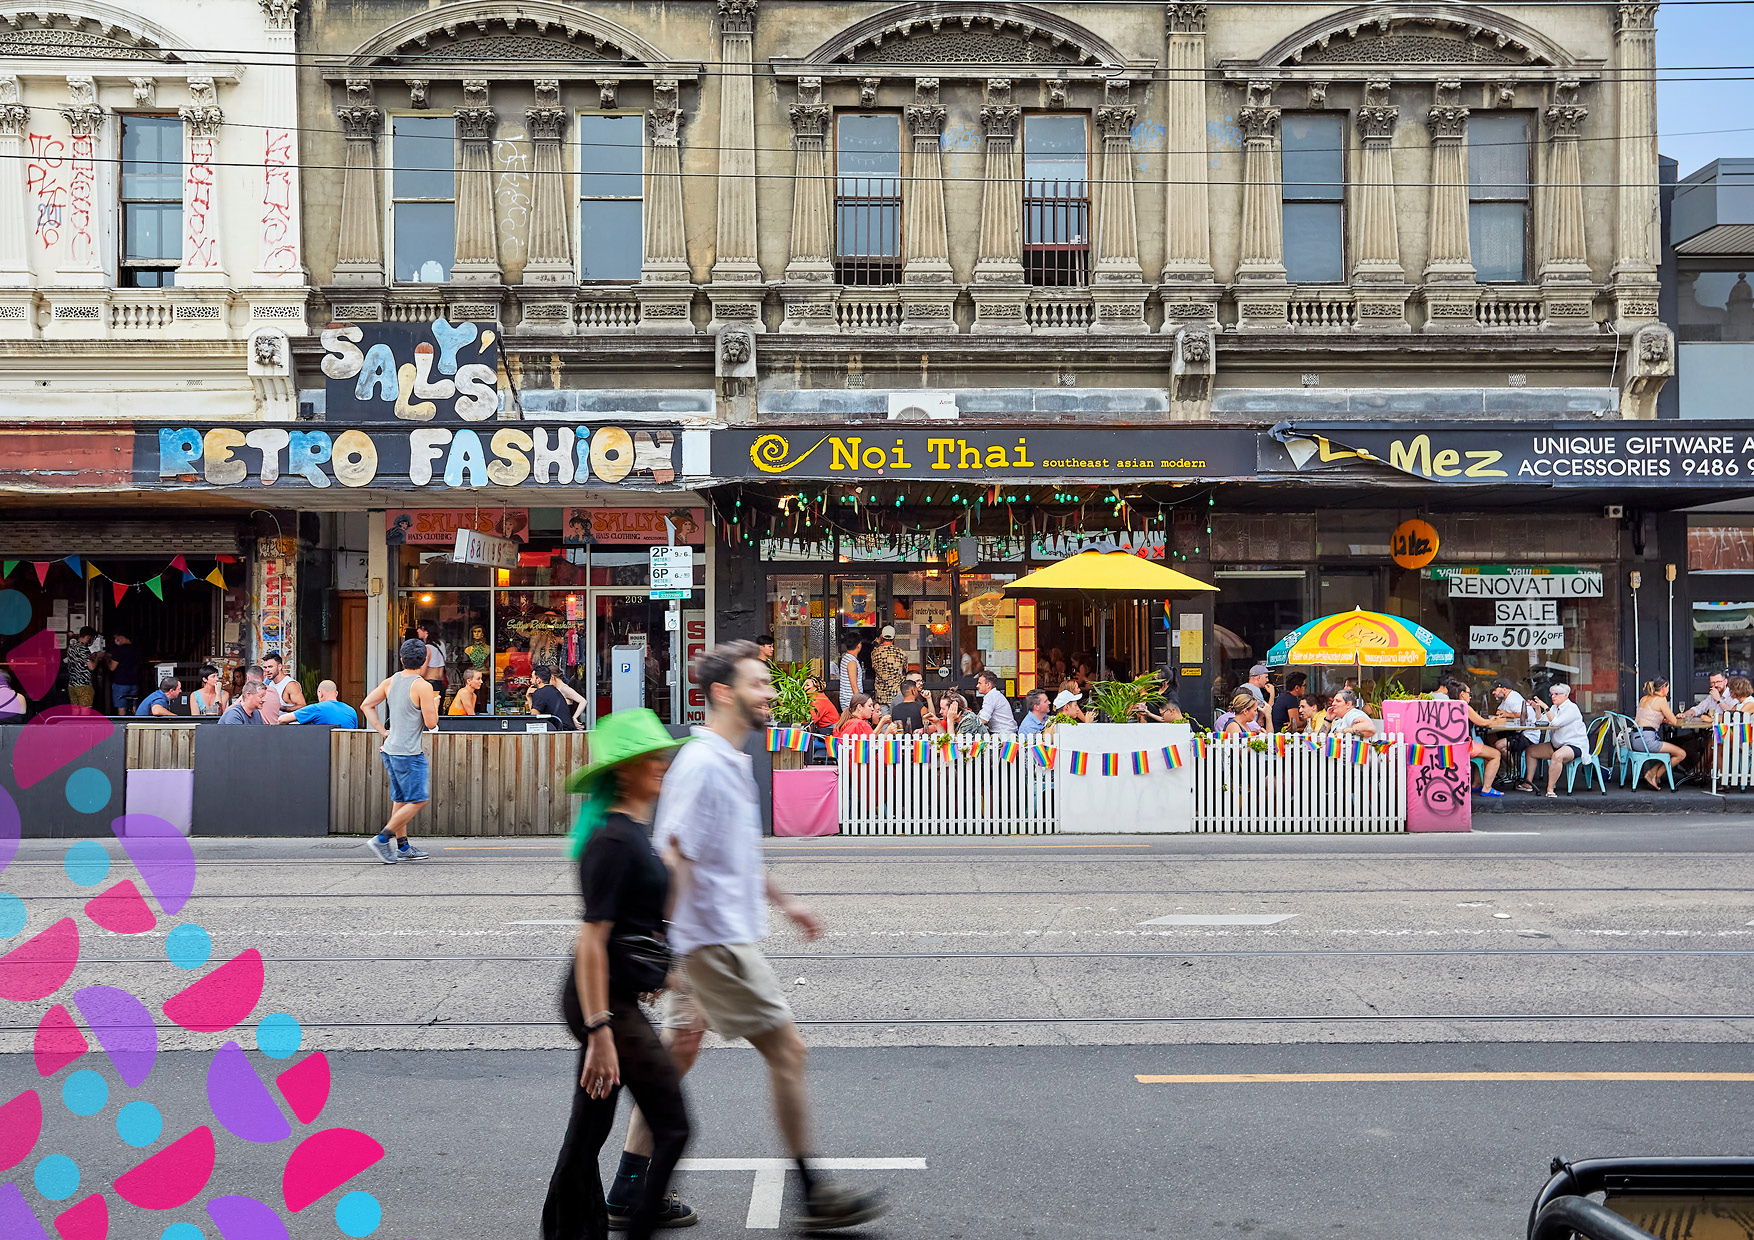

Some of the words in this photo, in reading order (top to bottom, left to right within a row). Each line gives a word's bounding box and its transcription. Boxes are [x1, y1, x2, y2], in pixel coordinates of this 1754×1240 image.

[320, 318, 498, 421] SALLY'S
[828, 437, 912, 470] Noi
[927, 437, 1034, 470] Thai
[1042, 457, 1110, 469] southeast
[1116, 457, 1154, 469] asian
[1160, 457, 1206, 469] modern
[1532, 437, 1616, 454] UNIQUE
[1624, 437, 1734, 454] GIFTWARE
[159, 427, 378, 488] RETRO
[1390, 434, 1508, 477] Mez
[1518, 458, 1671, 476] ACCESSORIES
[1682, 458, 1740, 476] 9486
[652, 547, 669, 557] 2P
[652, 568, 669, 579] 6P
[1449, 577, 1602, 595] RENOVATION
[625, 595, 643, 604] 203
[1497, 603, 1556, 621] SALE
[1502, 628, 1548, 648] 50%
[1548, 632, 1564, 640] OFF
